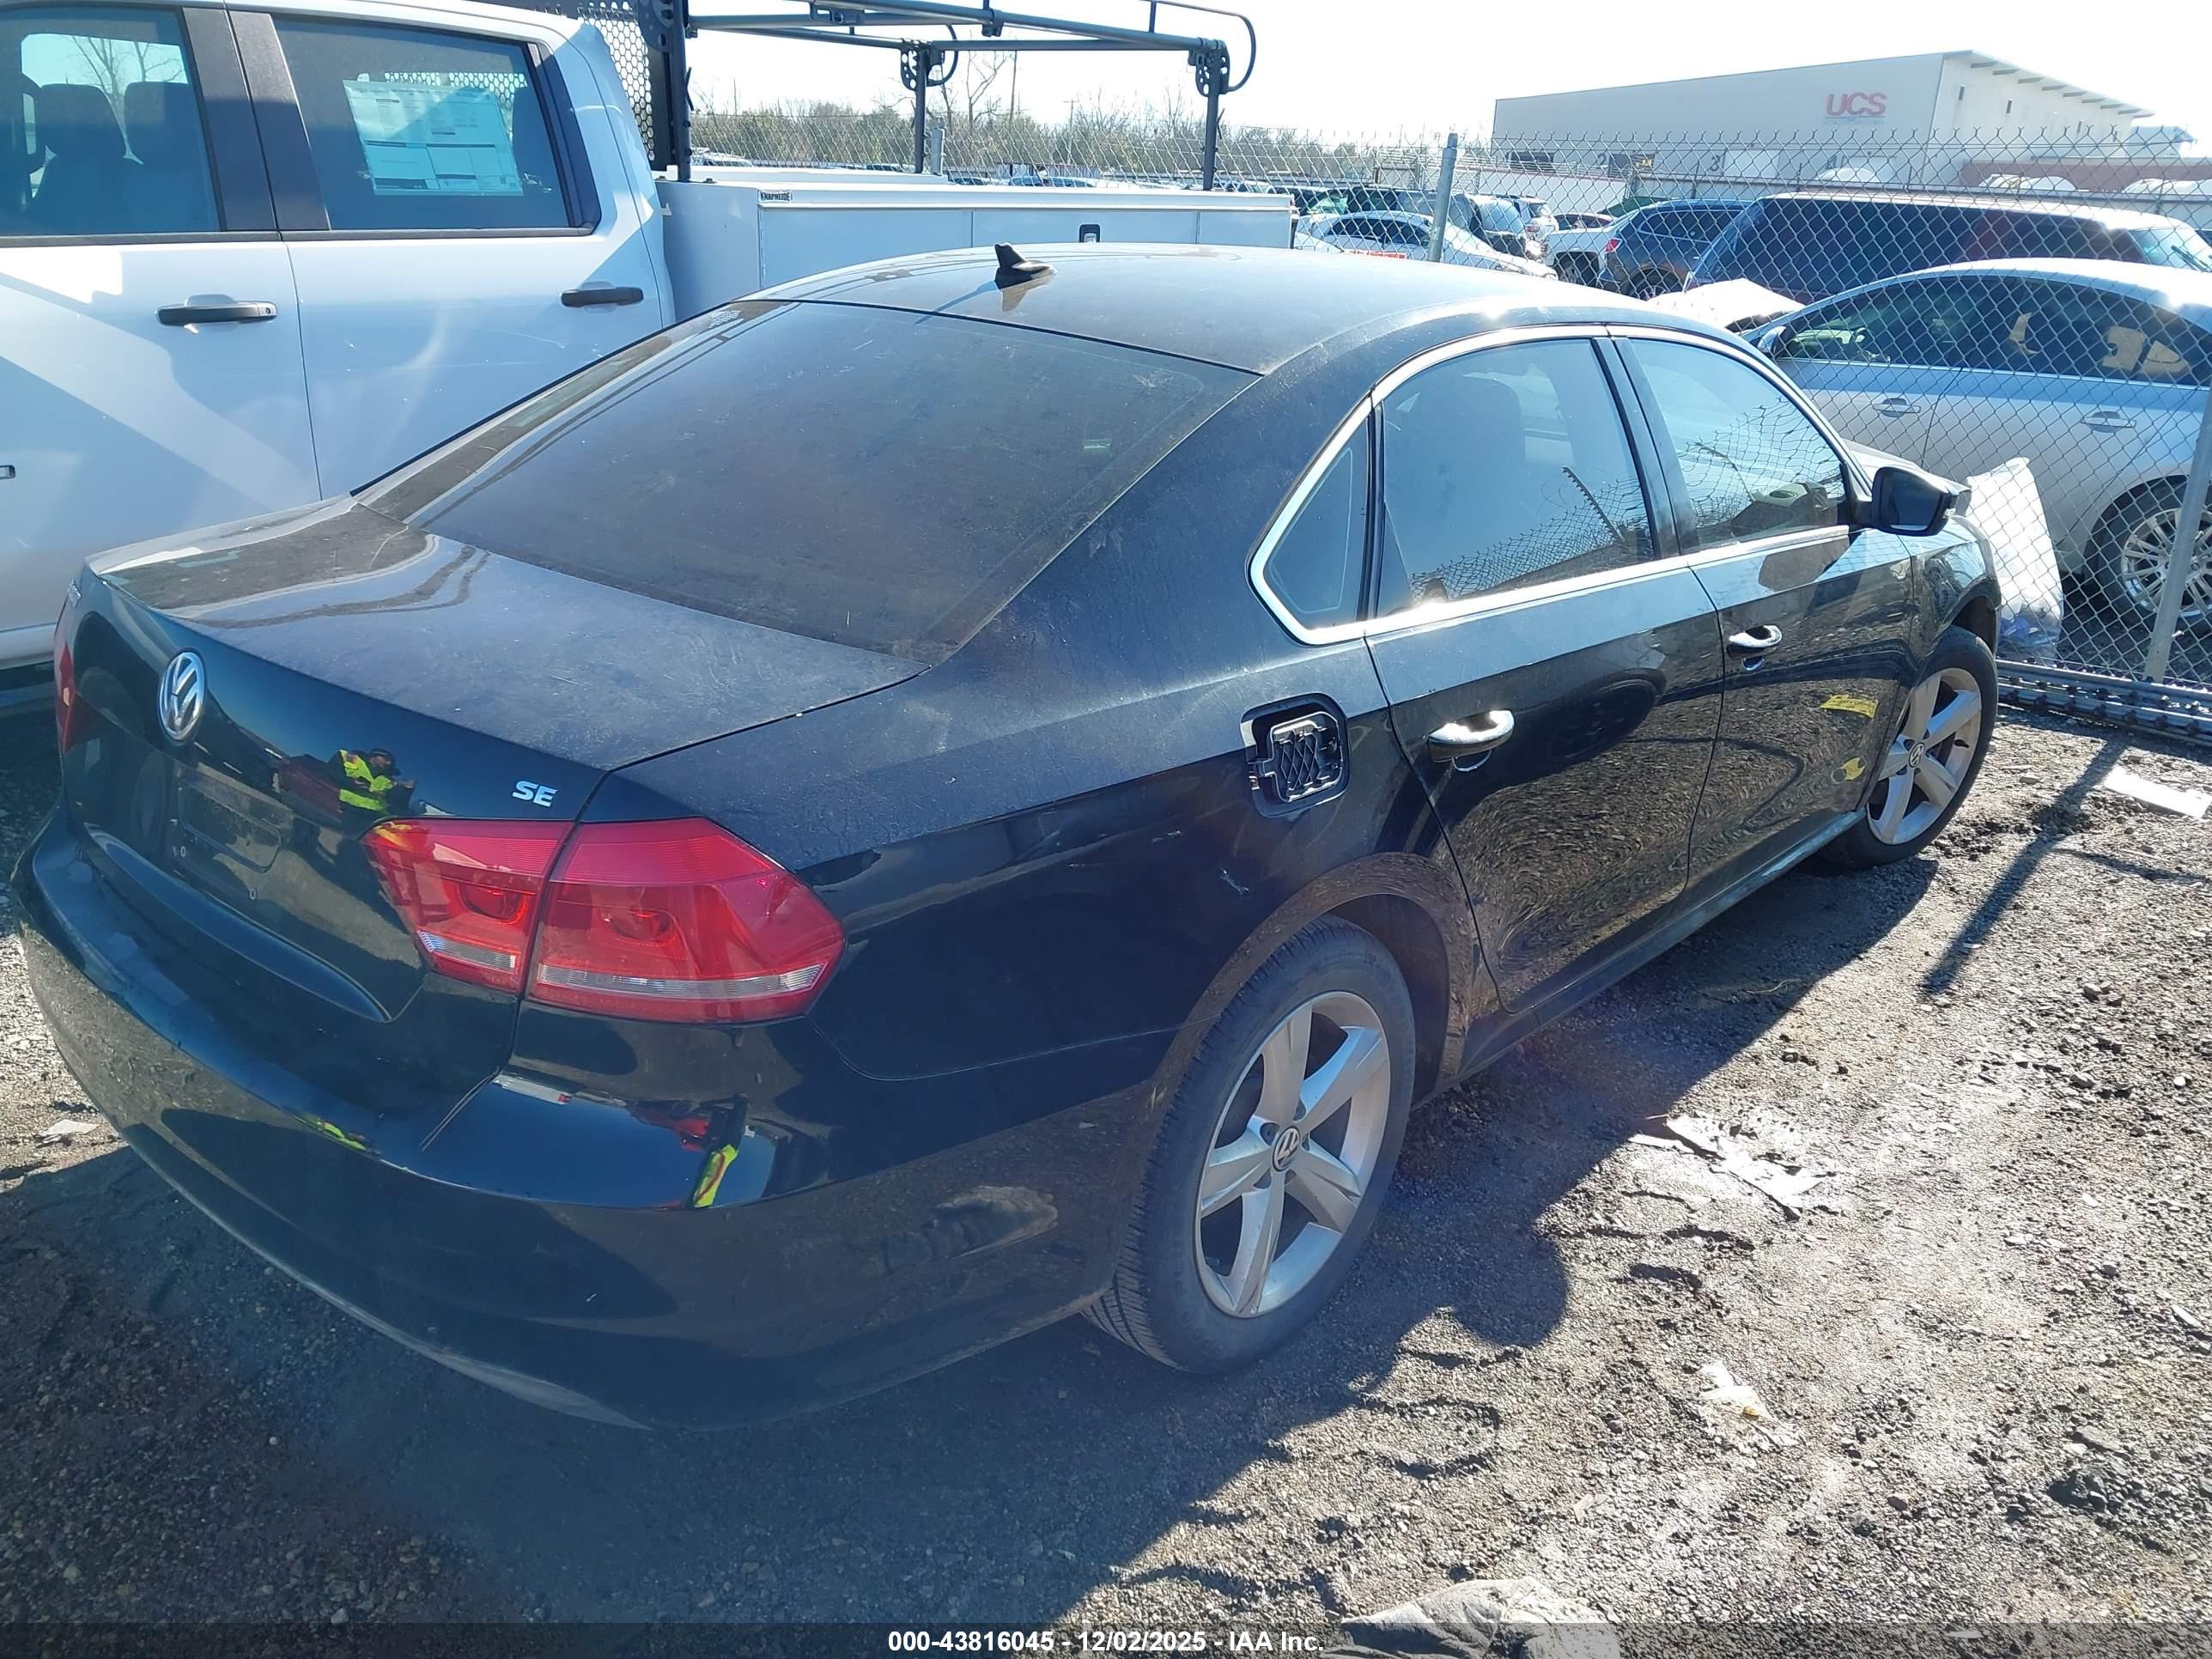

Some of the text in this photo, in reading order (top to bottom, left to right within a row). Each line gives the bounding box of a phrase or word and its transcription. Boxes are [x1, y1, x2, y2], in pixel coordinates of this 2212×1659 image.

[1826, 92, 1887, 116] UCS
[1711, 155, 1721, 171] 3
[512, 780, 558, 808] SE
